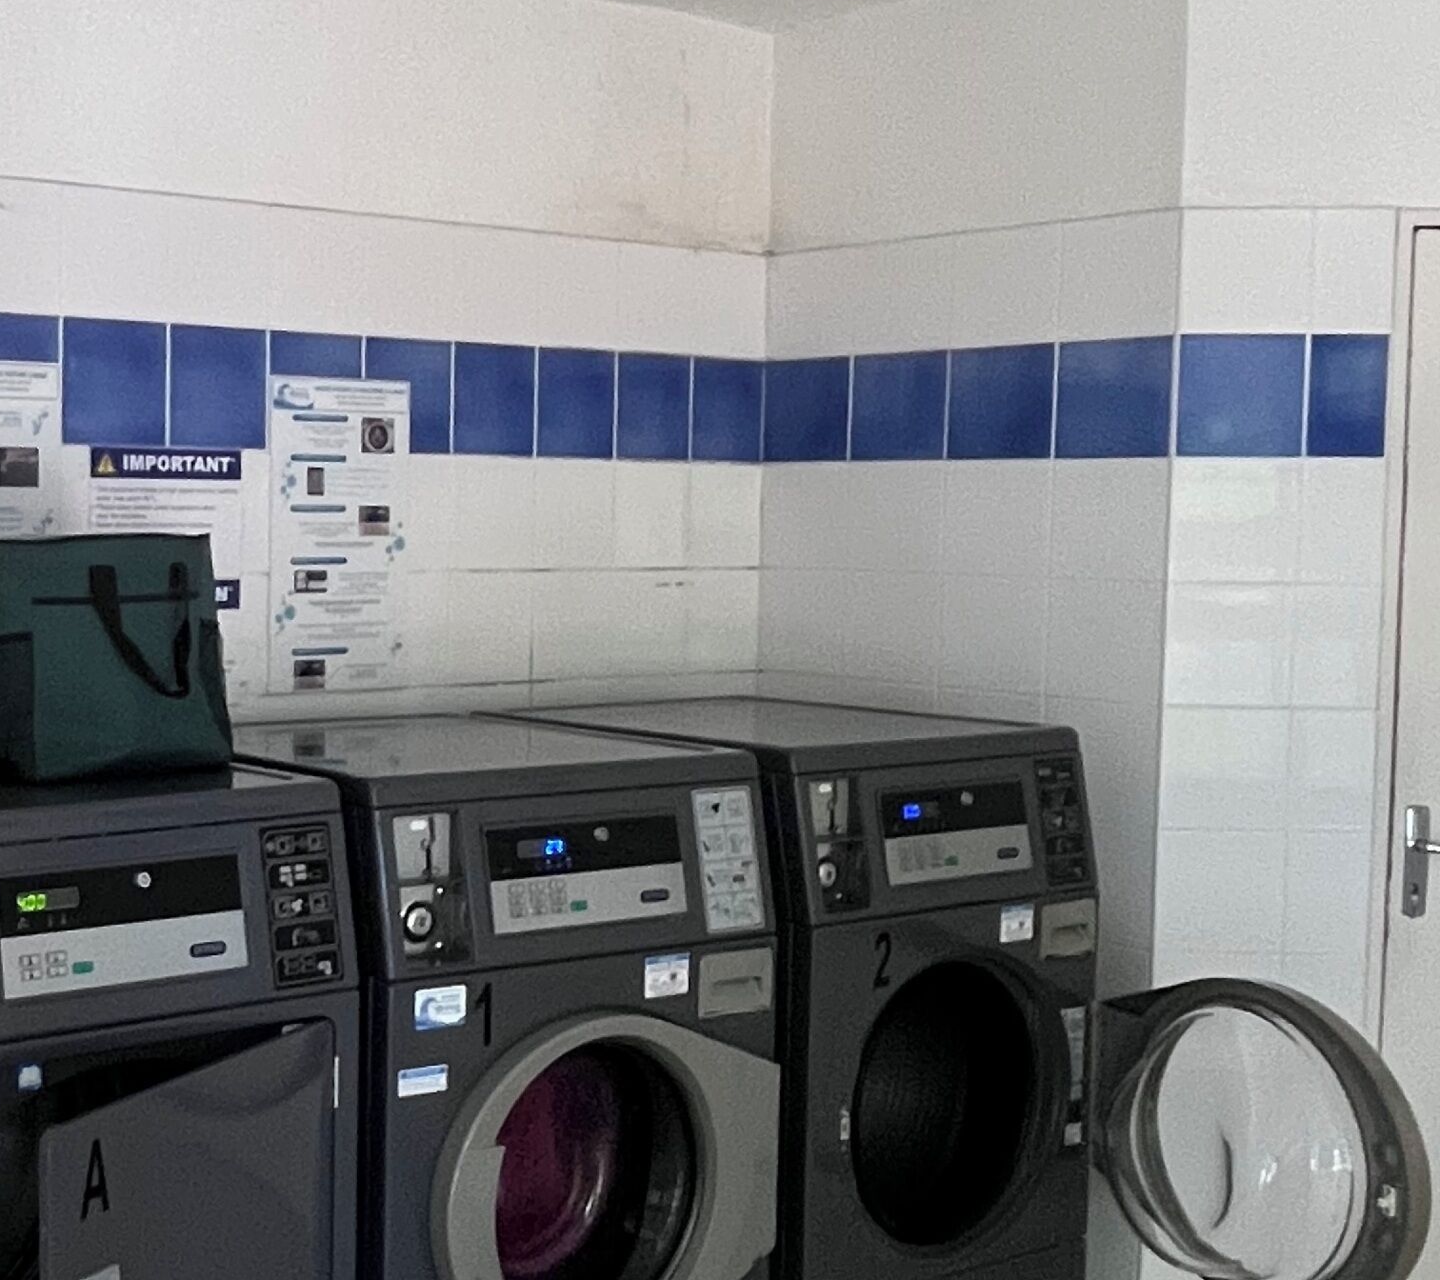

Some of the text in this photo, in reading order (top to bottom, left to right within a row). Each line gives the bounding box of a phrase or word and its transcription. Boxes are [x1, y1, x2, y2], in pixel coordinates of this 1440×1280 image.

[872, 931, 892, 991] 2
[474, 981, 493, 1048] 1
[80, 1138, 110, 1223] A
